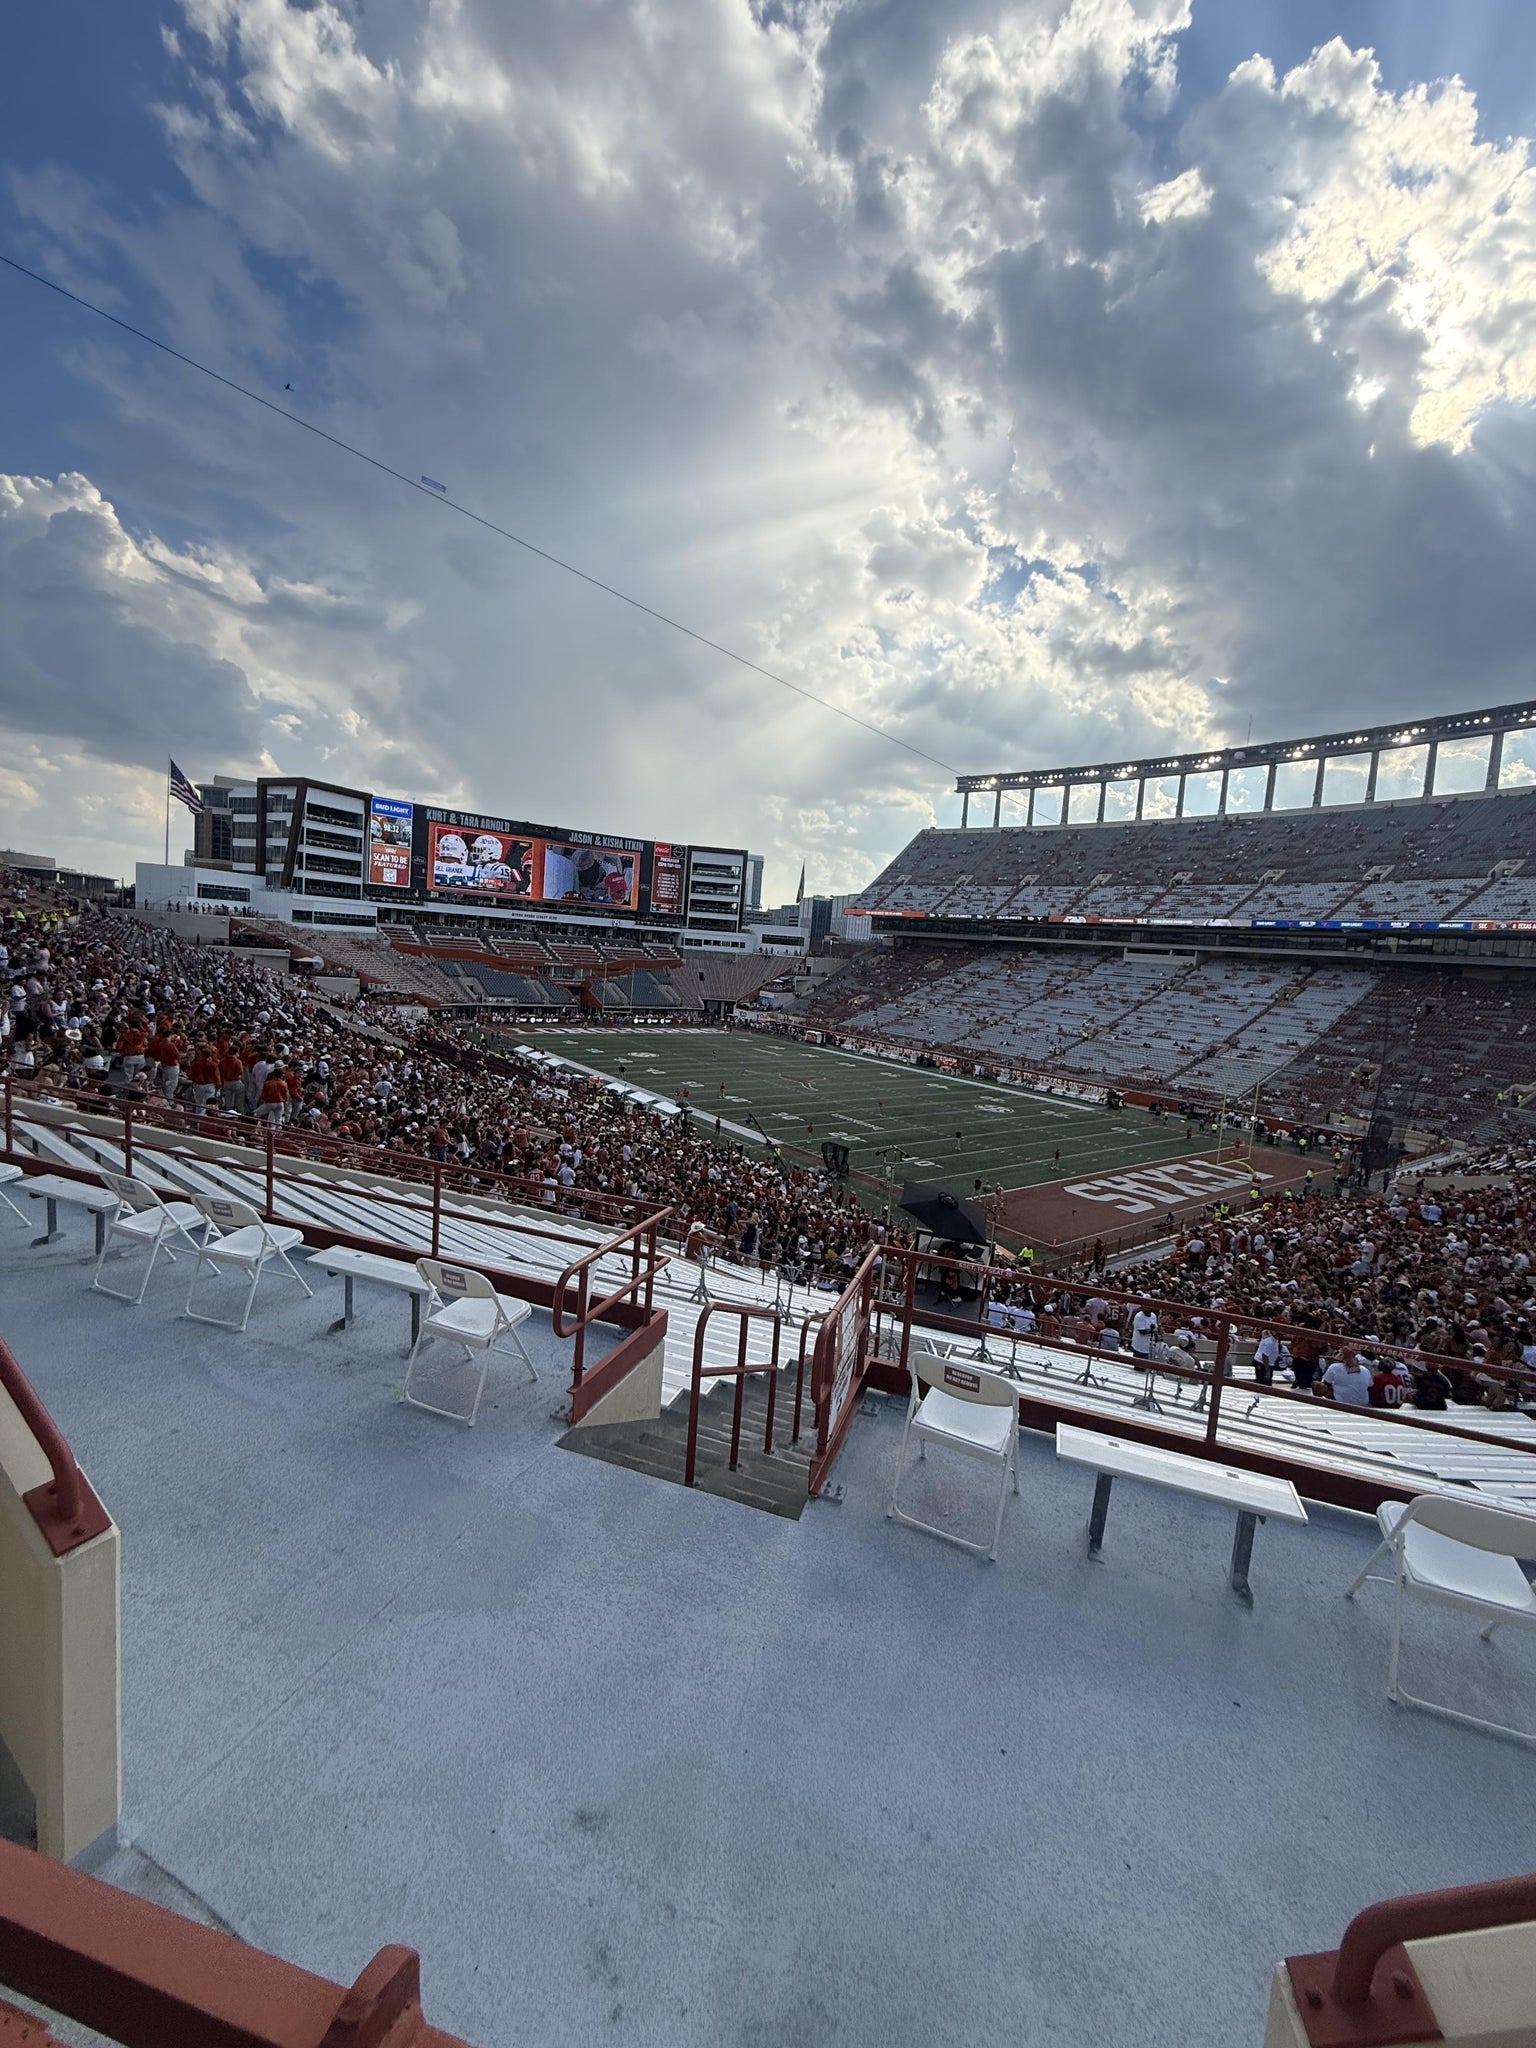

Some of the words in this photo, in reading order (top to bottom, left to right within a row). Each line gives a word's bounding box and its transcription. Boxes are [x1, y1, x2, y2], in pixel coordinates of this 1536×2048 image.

[375, 803, 389, 811] BUD
[390, 805, 409, 814] LIGHT
[426, 808, 448, 822] KURT
[448, 812, 458, 824] &
[460, 814, 479, 828] TARA
[480, 818, 510, 832] ARNOLD
[568, 831, 593, 845] JASON
[594, 836, 602, 846] &
[602, 836, 624, 849] KISHA
[625, 840, 644, 851] ITKIN
[373, 852, 389, 861] SCAN
[390, 854, 399, 863] TO
[399, 856, 408, 864] BE
[373, 861, 407, 870] FEATURED
[500, 868, 510, 876] 15
[1063, 1159, 1275, 1214] TEXAS
